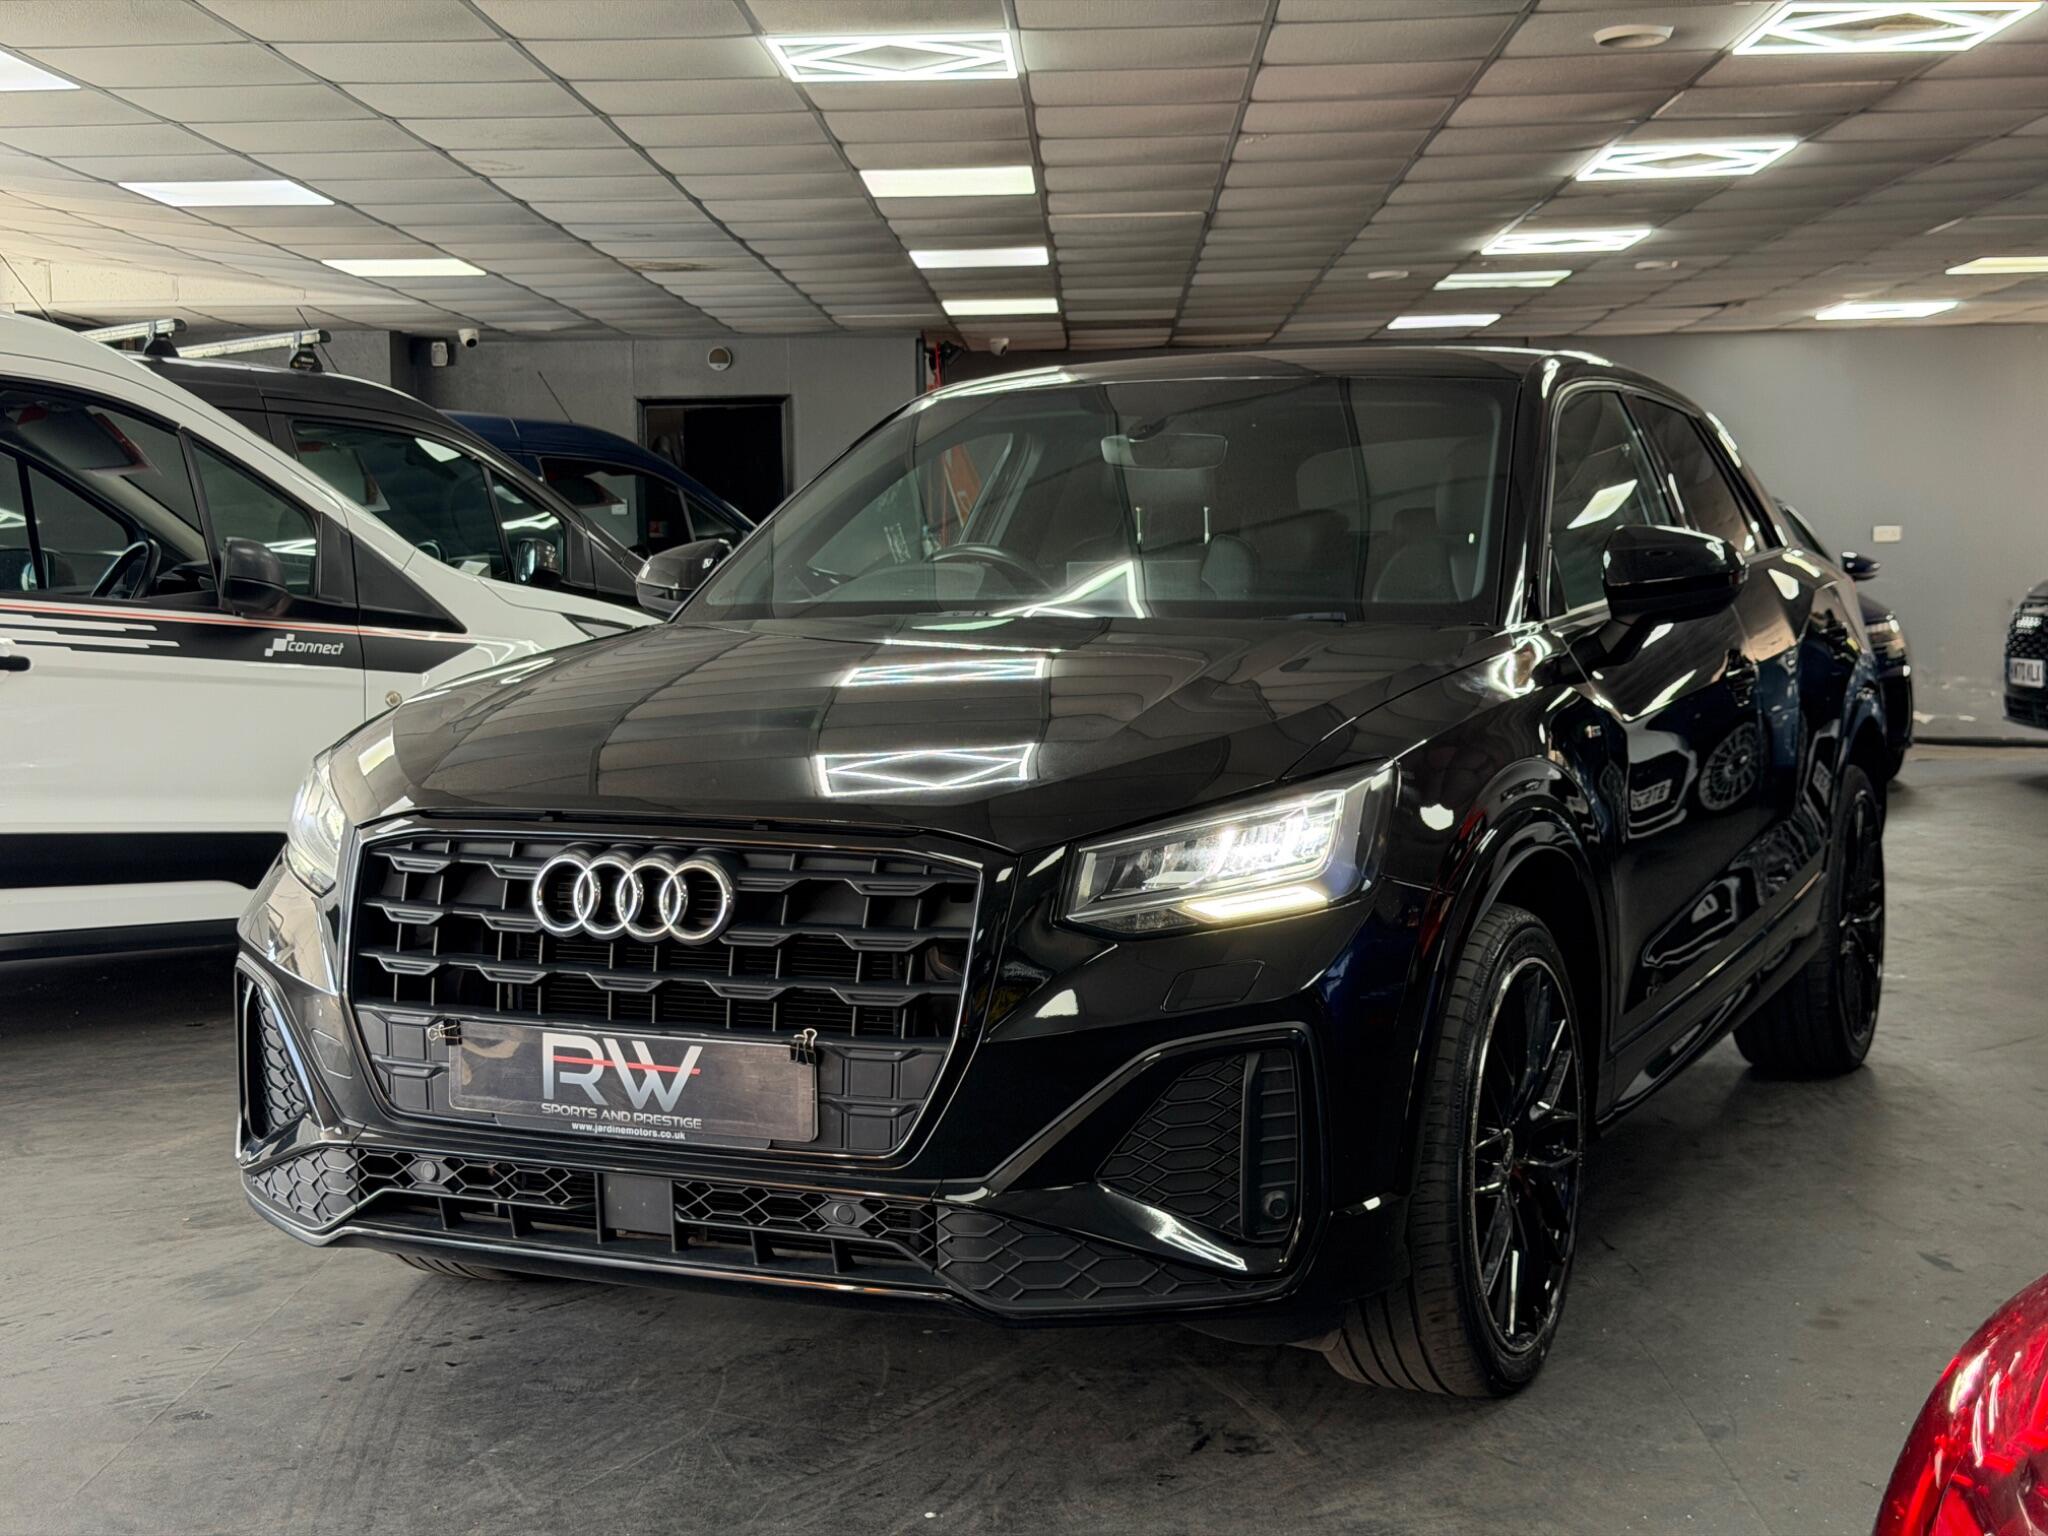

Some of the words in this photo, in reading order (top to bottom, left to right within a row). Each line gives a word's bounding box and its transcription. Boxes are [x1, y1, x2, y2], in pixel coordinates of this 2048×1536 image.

[288, 641, 344, 655] connect
[542, 1032, 703, 1113] RW
[541, 1102, 598, 1119] SPORTS
[600, 1109, 631, 1122] AND
[634, 1113, 703, 1130] PRESTIGE
[571, 1122, 686, 1140] www.jardinemotors.co.uk
